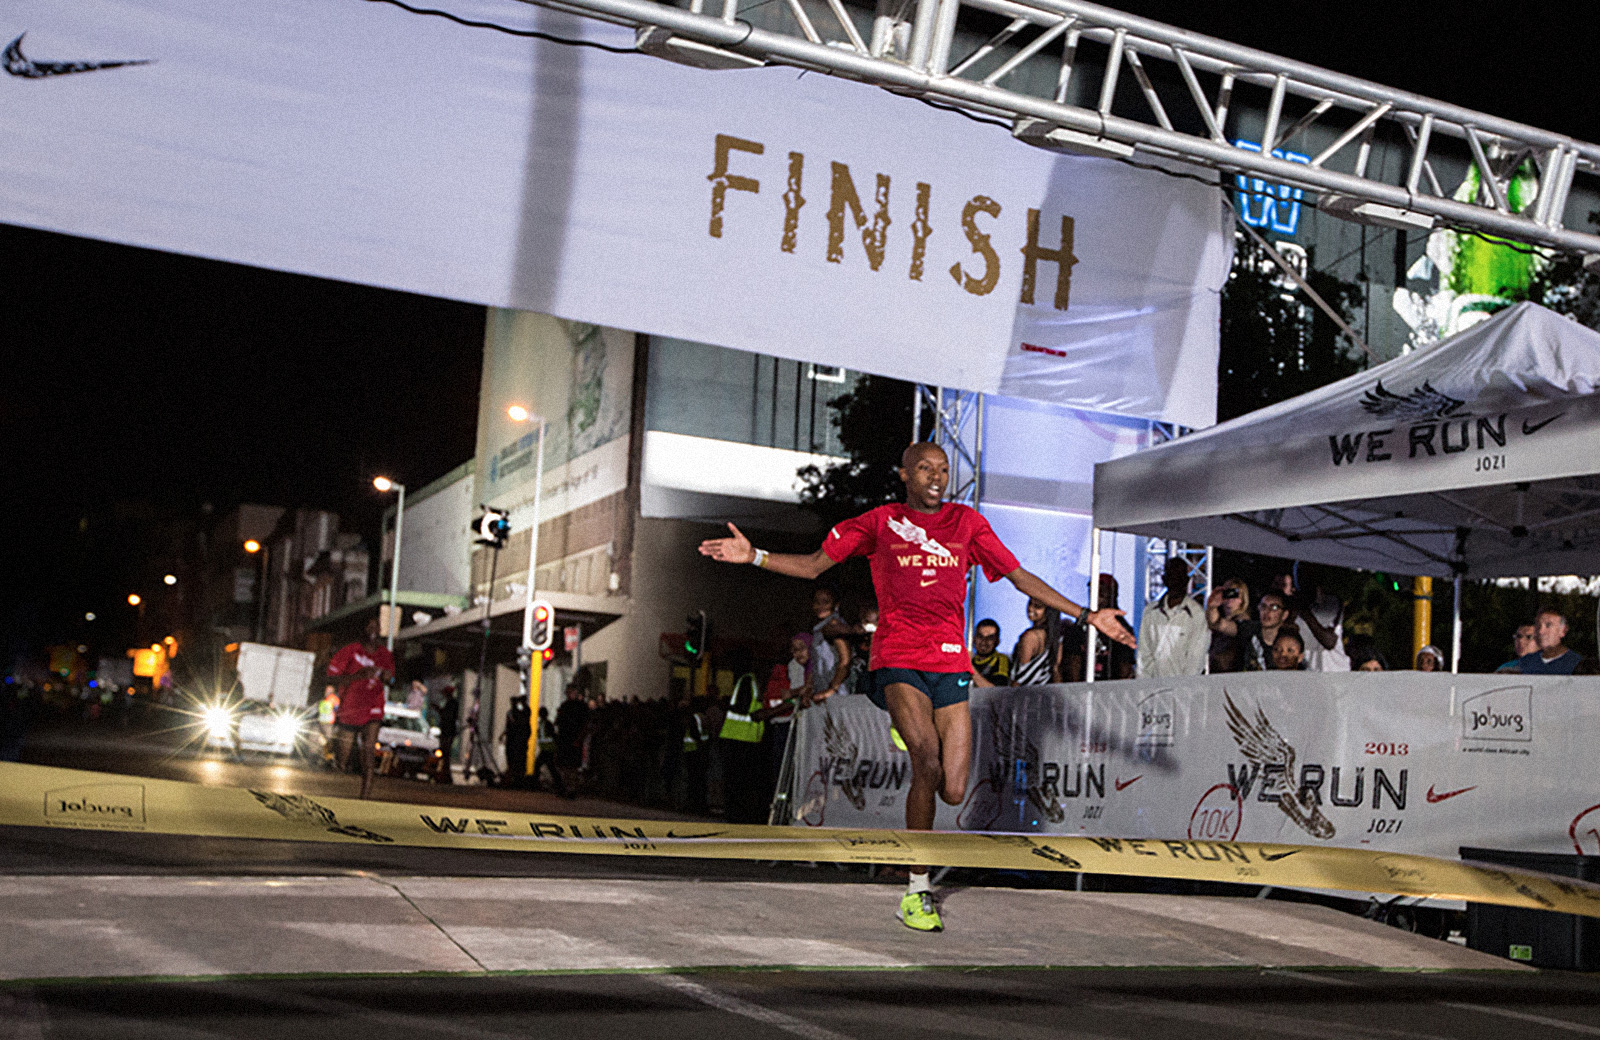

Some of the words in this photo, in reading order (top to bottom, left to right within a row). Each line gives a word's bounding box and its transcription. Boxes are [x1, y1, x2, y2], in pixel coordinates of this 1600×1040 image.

[706, 133, 1080, 312] FINISH
[1328, 428, 1394, 467] WE
[1408, 412, 1509, 458] RUN
[1474, 454, 1507, 472] JOZI
[896, 554, 924, 568] WE
[926, 555, 959, 568] RUN
[1364, 742, 1410, 757] 2013
[1043, 761, 1106, 799] RUN
[1227, 763, 1287, 803] WE
[1299, 764, 1409, 811] RUN
[419, 814, 508, 836] WE
[528, 821, 650, 842] RUN
[1199, 808, 1235, 840] 10K
[1366, 817, 1404, 834] JOZI
[1084, 836, 1158, 857] WE
[1162, 839, 1251, 864] RUN
